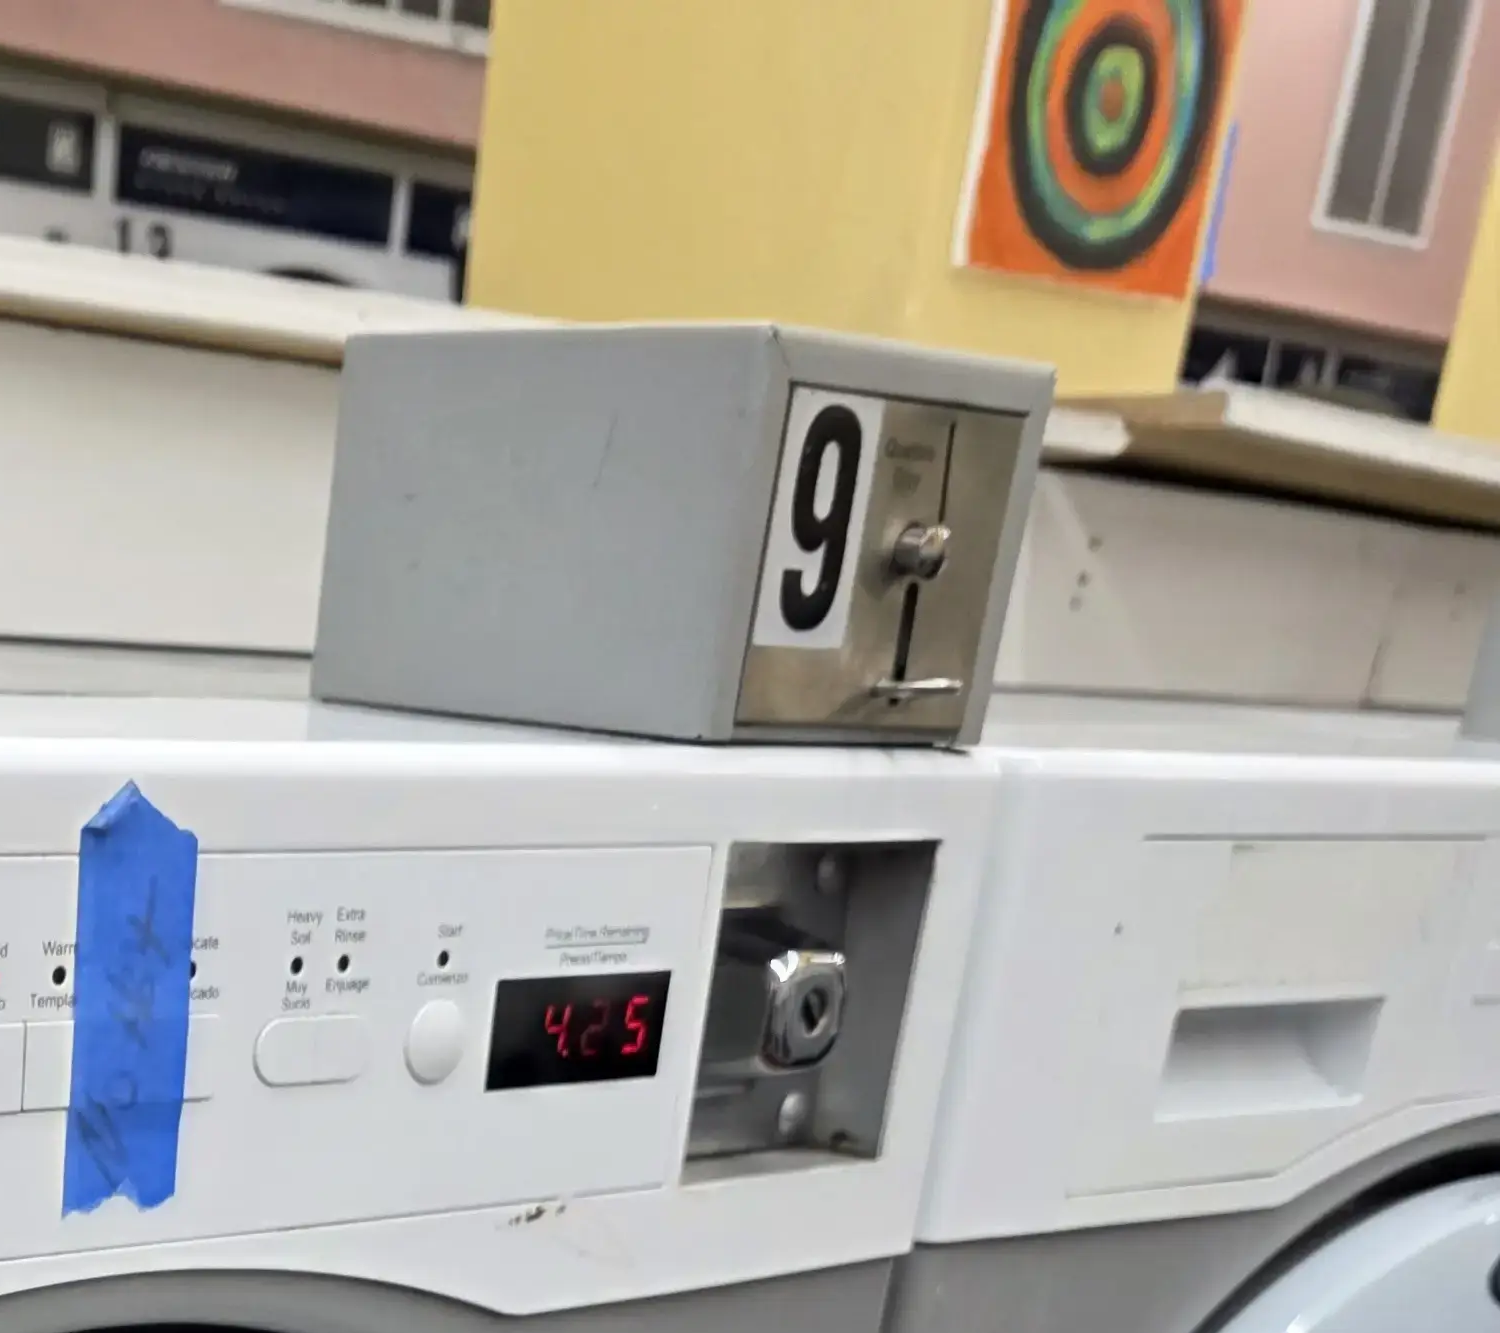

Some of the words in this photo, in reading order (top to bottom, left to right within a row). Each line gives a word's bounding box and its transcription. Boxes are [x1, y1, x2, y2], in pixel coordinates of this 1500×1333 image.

[779, 404, 863, 632] 9
[287, 911, 323, 925] Heavy
[337, 908, 366, 922] Extra
[335, 930, 366, 943] Rinse
[438, 923, 463, 938] Start
[191, 936, 219, 950] cate
[291, 931, 312, 945] Soil
[190, 986, 219, 1000] cado
[286, 981, 308, 995] Muy
[30, 993, 76, 1011] Templa
